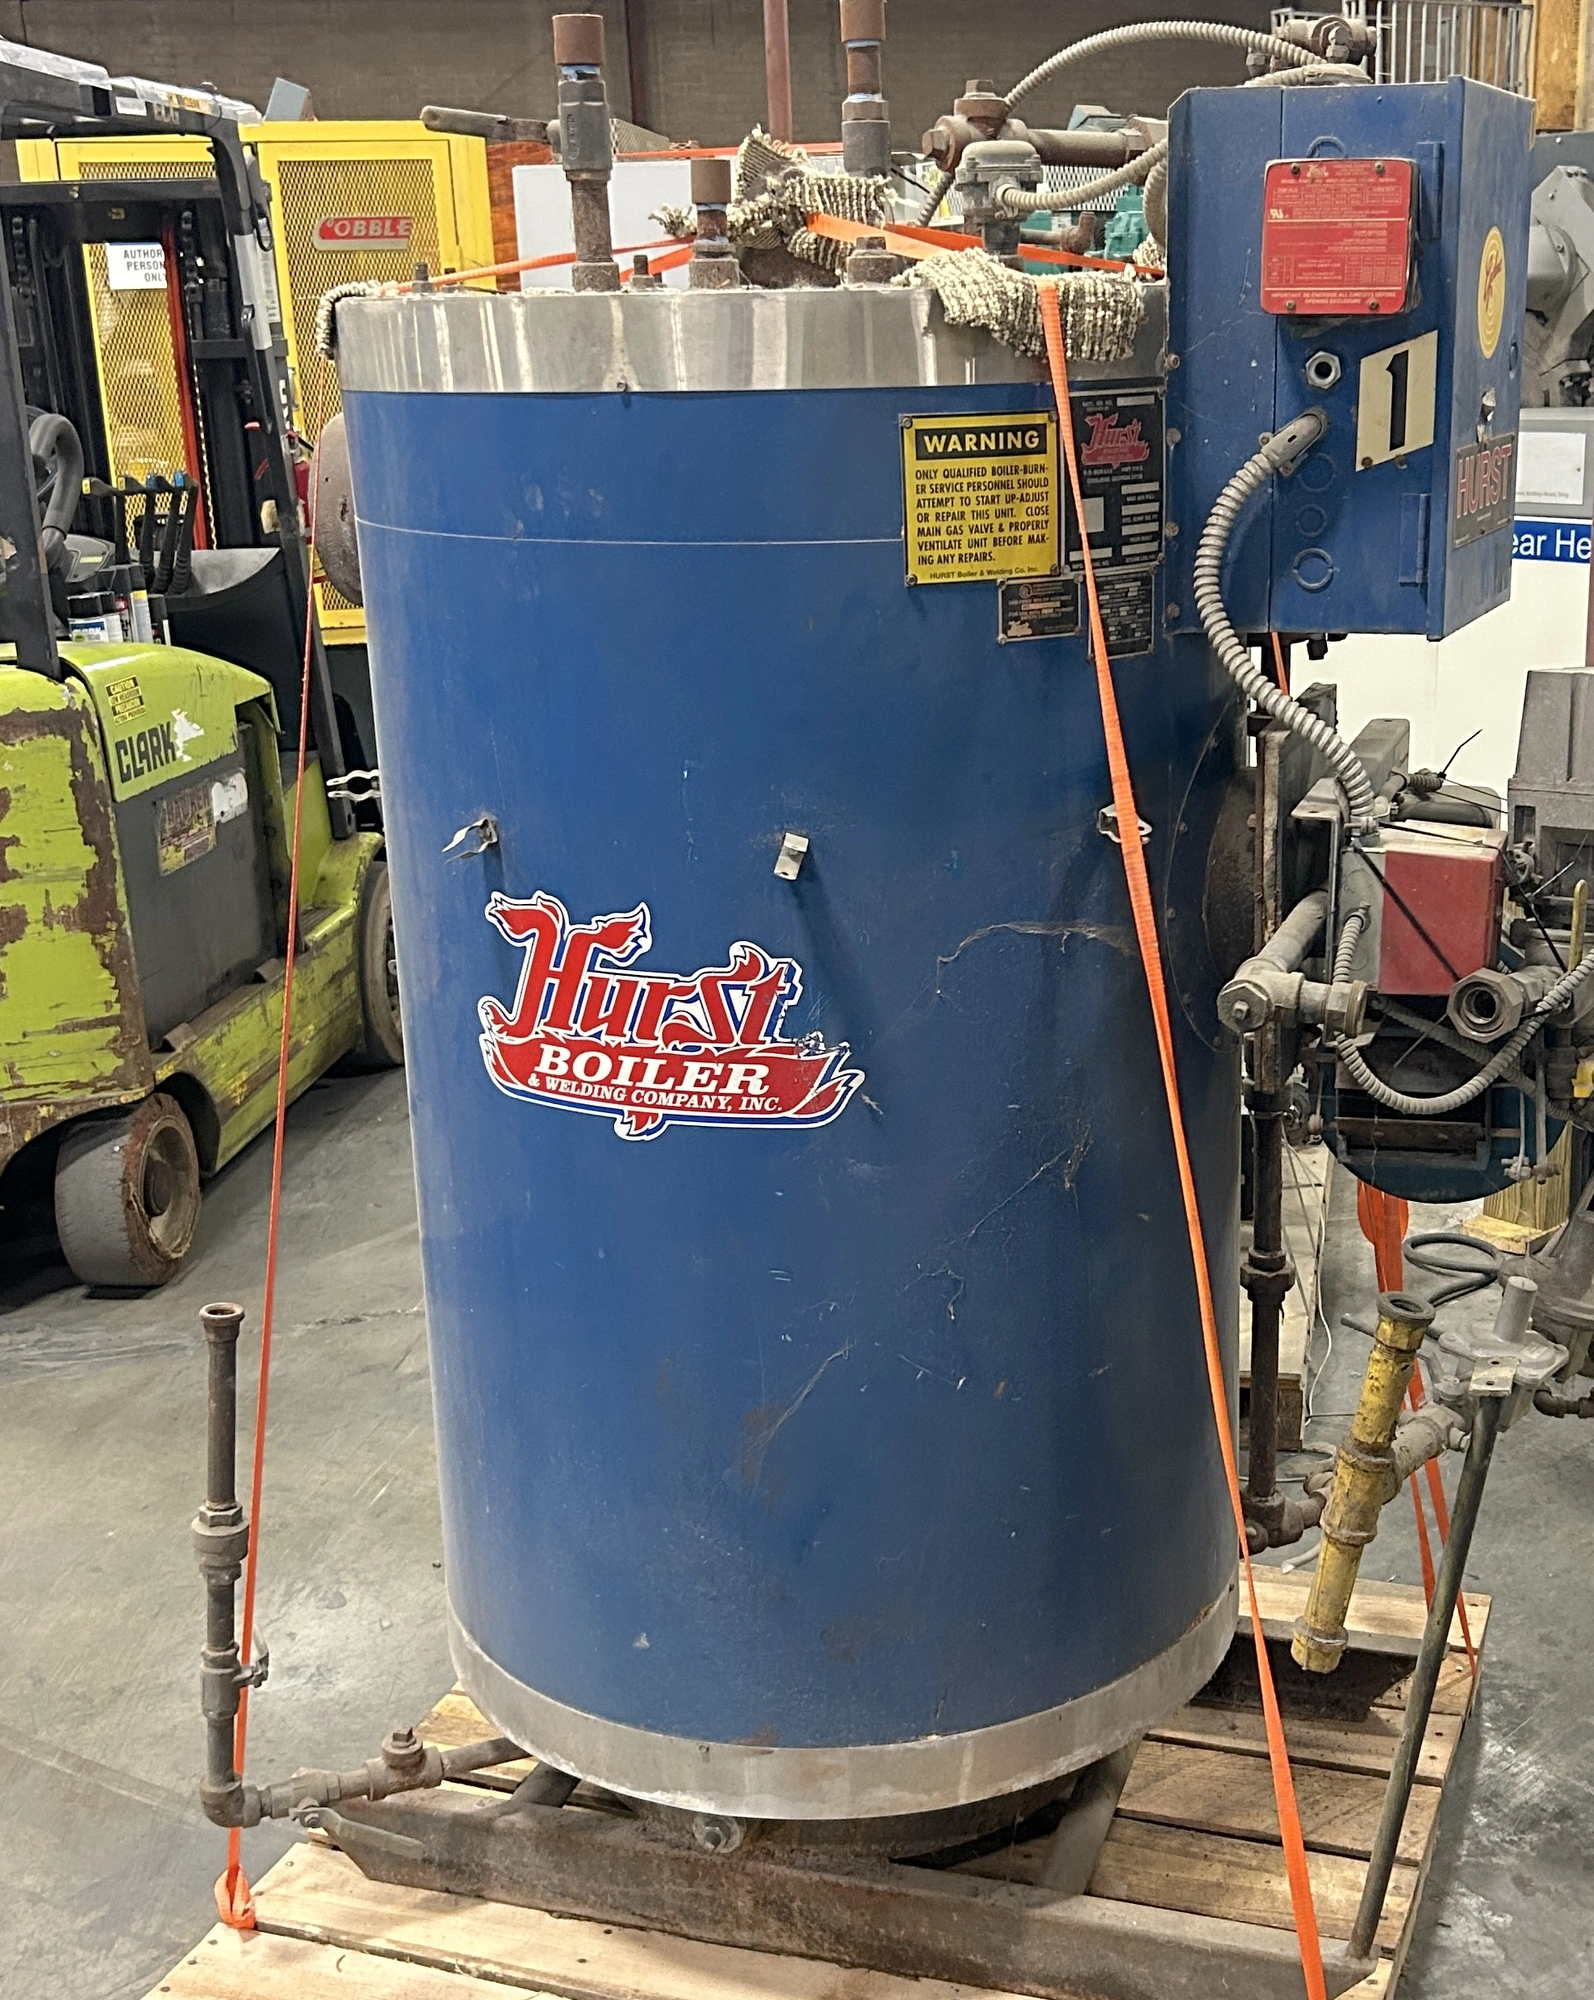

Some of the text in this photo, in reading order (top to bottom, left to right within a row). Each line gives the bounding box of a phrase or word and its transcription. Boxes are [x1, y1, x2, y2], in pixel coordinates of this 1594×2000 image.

[1385, 349, 1410, 452] 1
[923, 430, 1040, 453] WARNING
[915, 463, 1049, 480] ONLY QUALIFIED BOILER-BURN-
[1456, 443, 1512, 519] HURST
[916, 477, 1049, 494] ER SERVICE PERSONNEL SHOULD
[916, 491, 1049, 509] ATTEMPT TO START UP-ADJUST
[917, 505, 1049, 523] OR REPAIR THIS UNIT. CLOSE
[917, 520, 1049, 537] MAIN GAS VALVE & PROPERLY
[918, 533, 1049, 552] VENTILATE UNIT BEFORE MAK-
[1555, 529, 1591, 560] He
[918, 551, 995, 566] ING ANY REPAIRS.
[957, 570, 978, 578] Boiler
[986, 568, 1013, 577] Welding
[115, 721, 176, 783] CLARK
[484, 894, 798, 1052] Hurst
[534, 1043, 769, 1095] BOILER
[527, 1073, 782, 1112] & WELDING COMPANY, INC.
